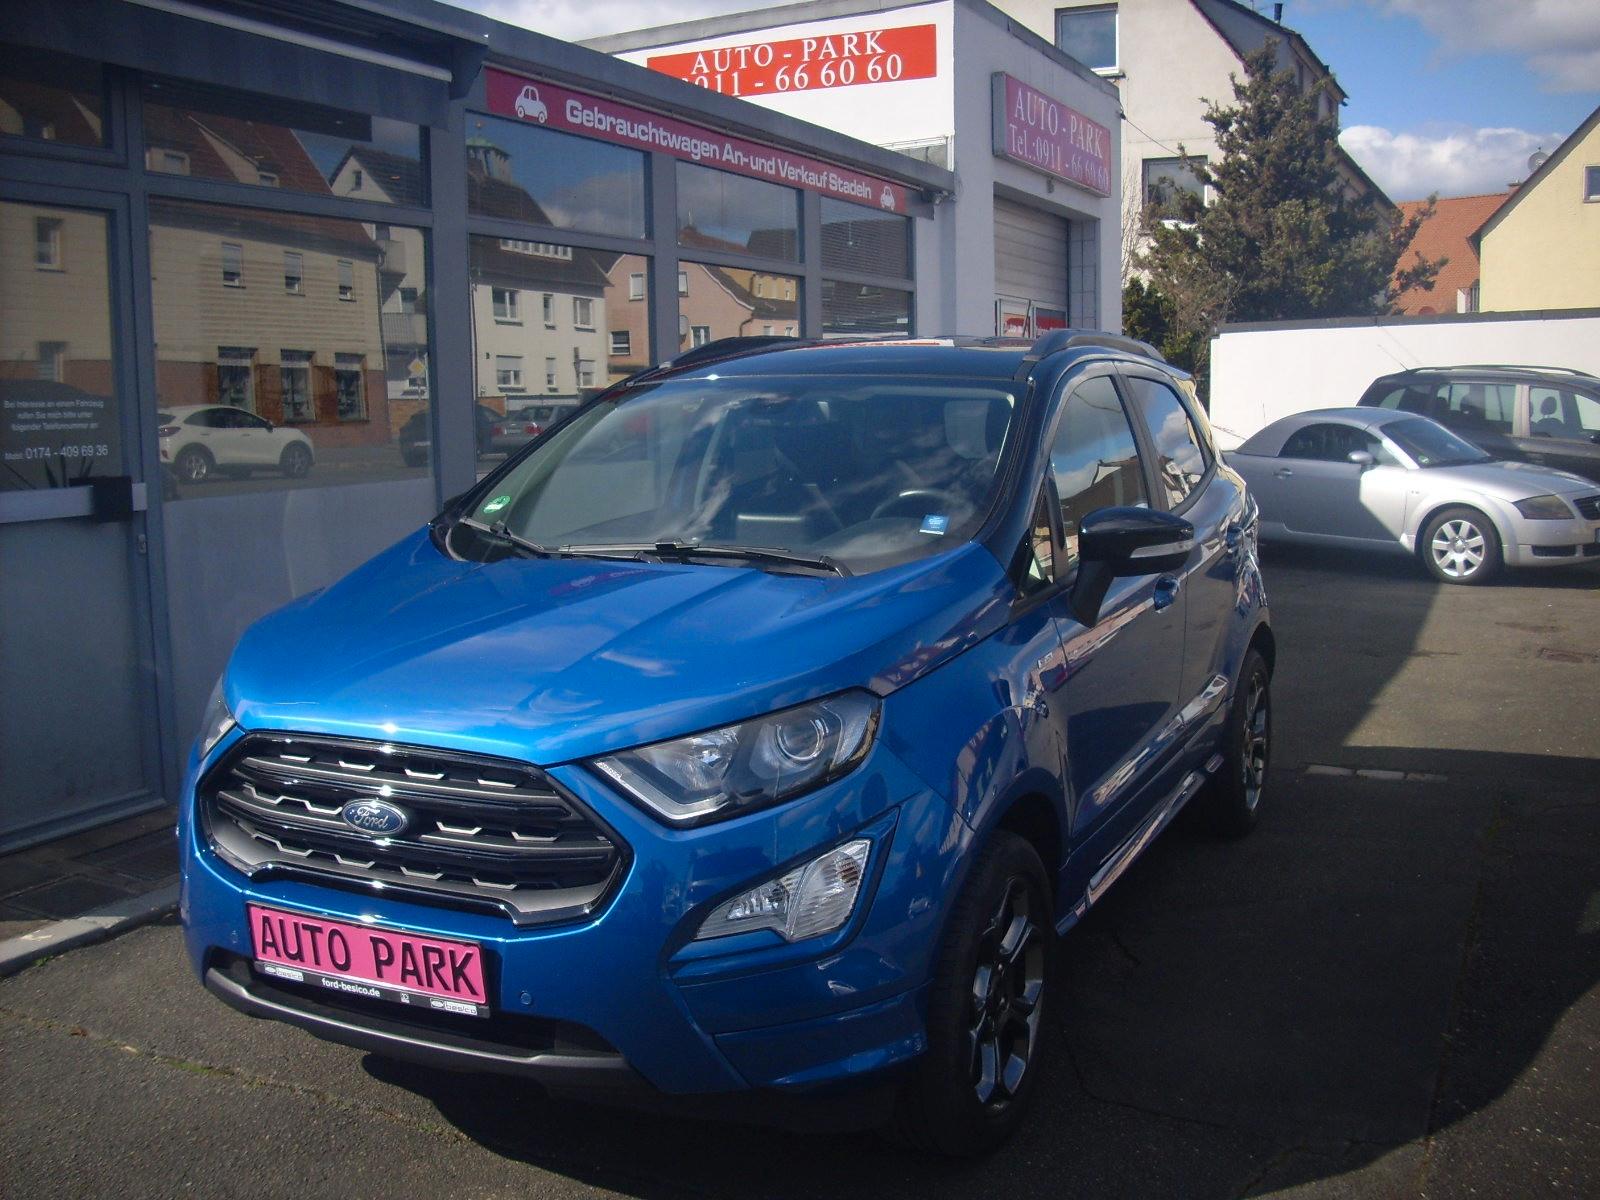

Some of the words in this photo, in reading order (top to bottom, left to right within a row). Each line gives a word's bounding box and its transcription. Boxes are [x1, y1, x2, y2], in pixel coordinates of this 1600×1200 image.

[691, 44, 773, 75] AUTO
[802, 30, 886, 62] PARK
[775, 63, 809, 91] 66
[820, 59, 855, 87] 60
[867, 54, 902, 82] 60
[1015, 87, 1058, 136] AUTO
[1070, 115, 1102, 159] PARK
[566, 99, 720, 160] Gebrauchtwagen
[777, 158, 828, 189] Verkauf
[828, 173, 872, 199] Stadeln
[25, 447, 51, 459] 0174
[59, 445, 79, 457] 409
[81, 445, 94, 457] 69
[96, 444, 108, 456] 36
[354, 806, 389, 829] Ford
[261, 915, 351, 972] AUTO
[370, 936, 480, 996] PARK
[322, 978, 381, 997] ford-besico.de
